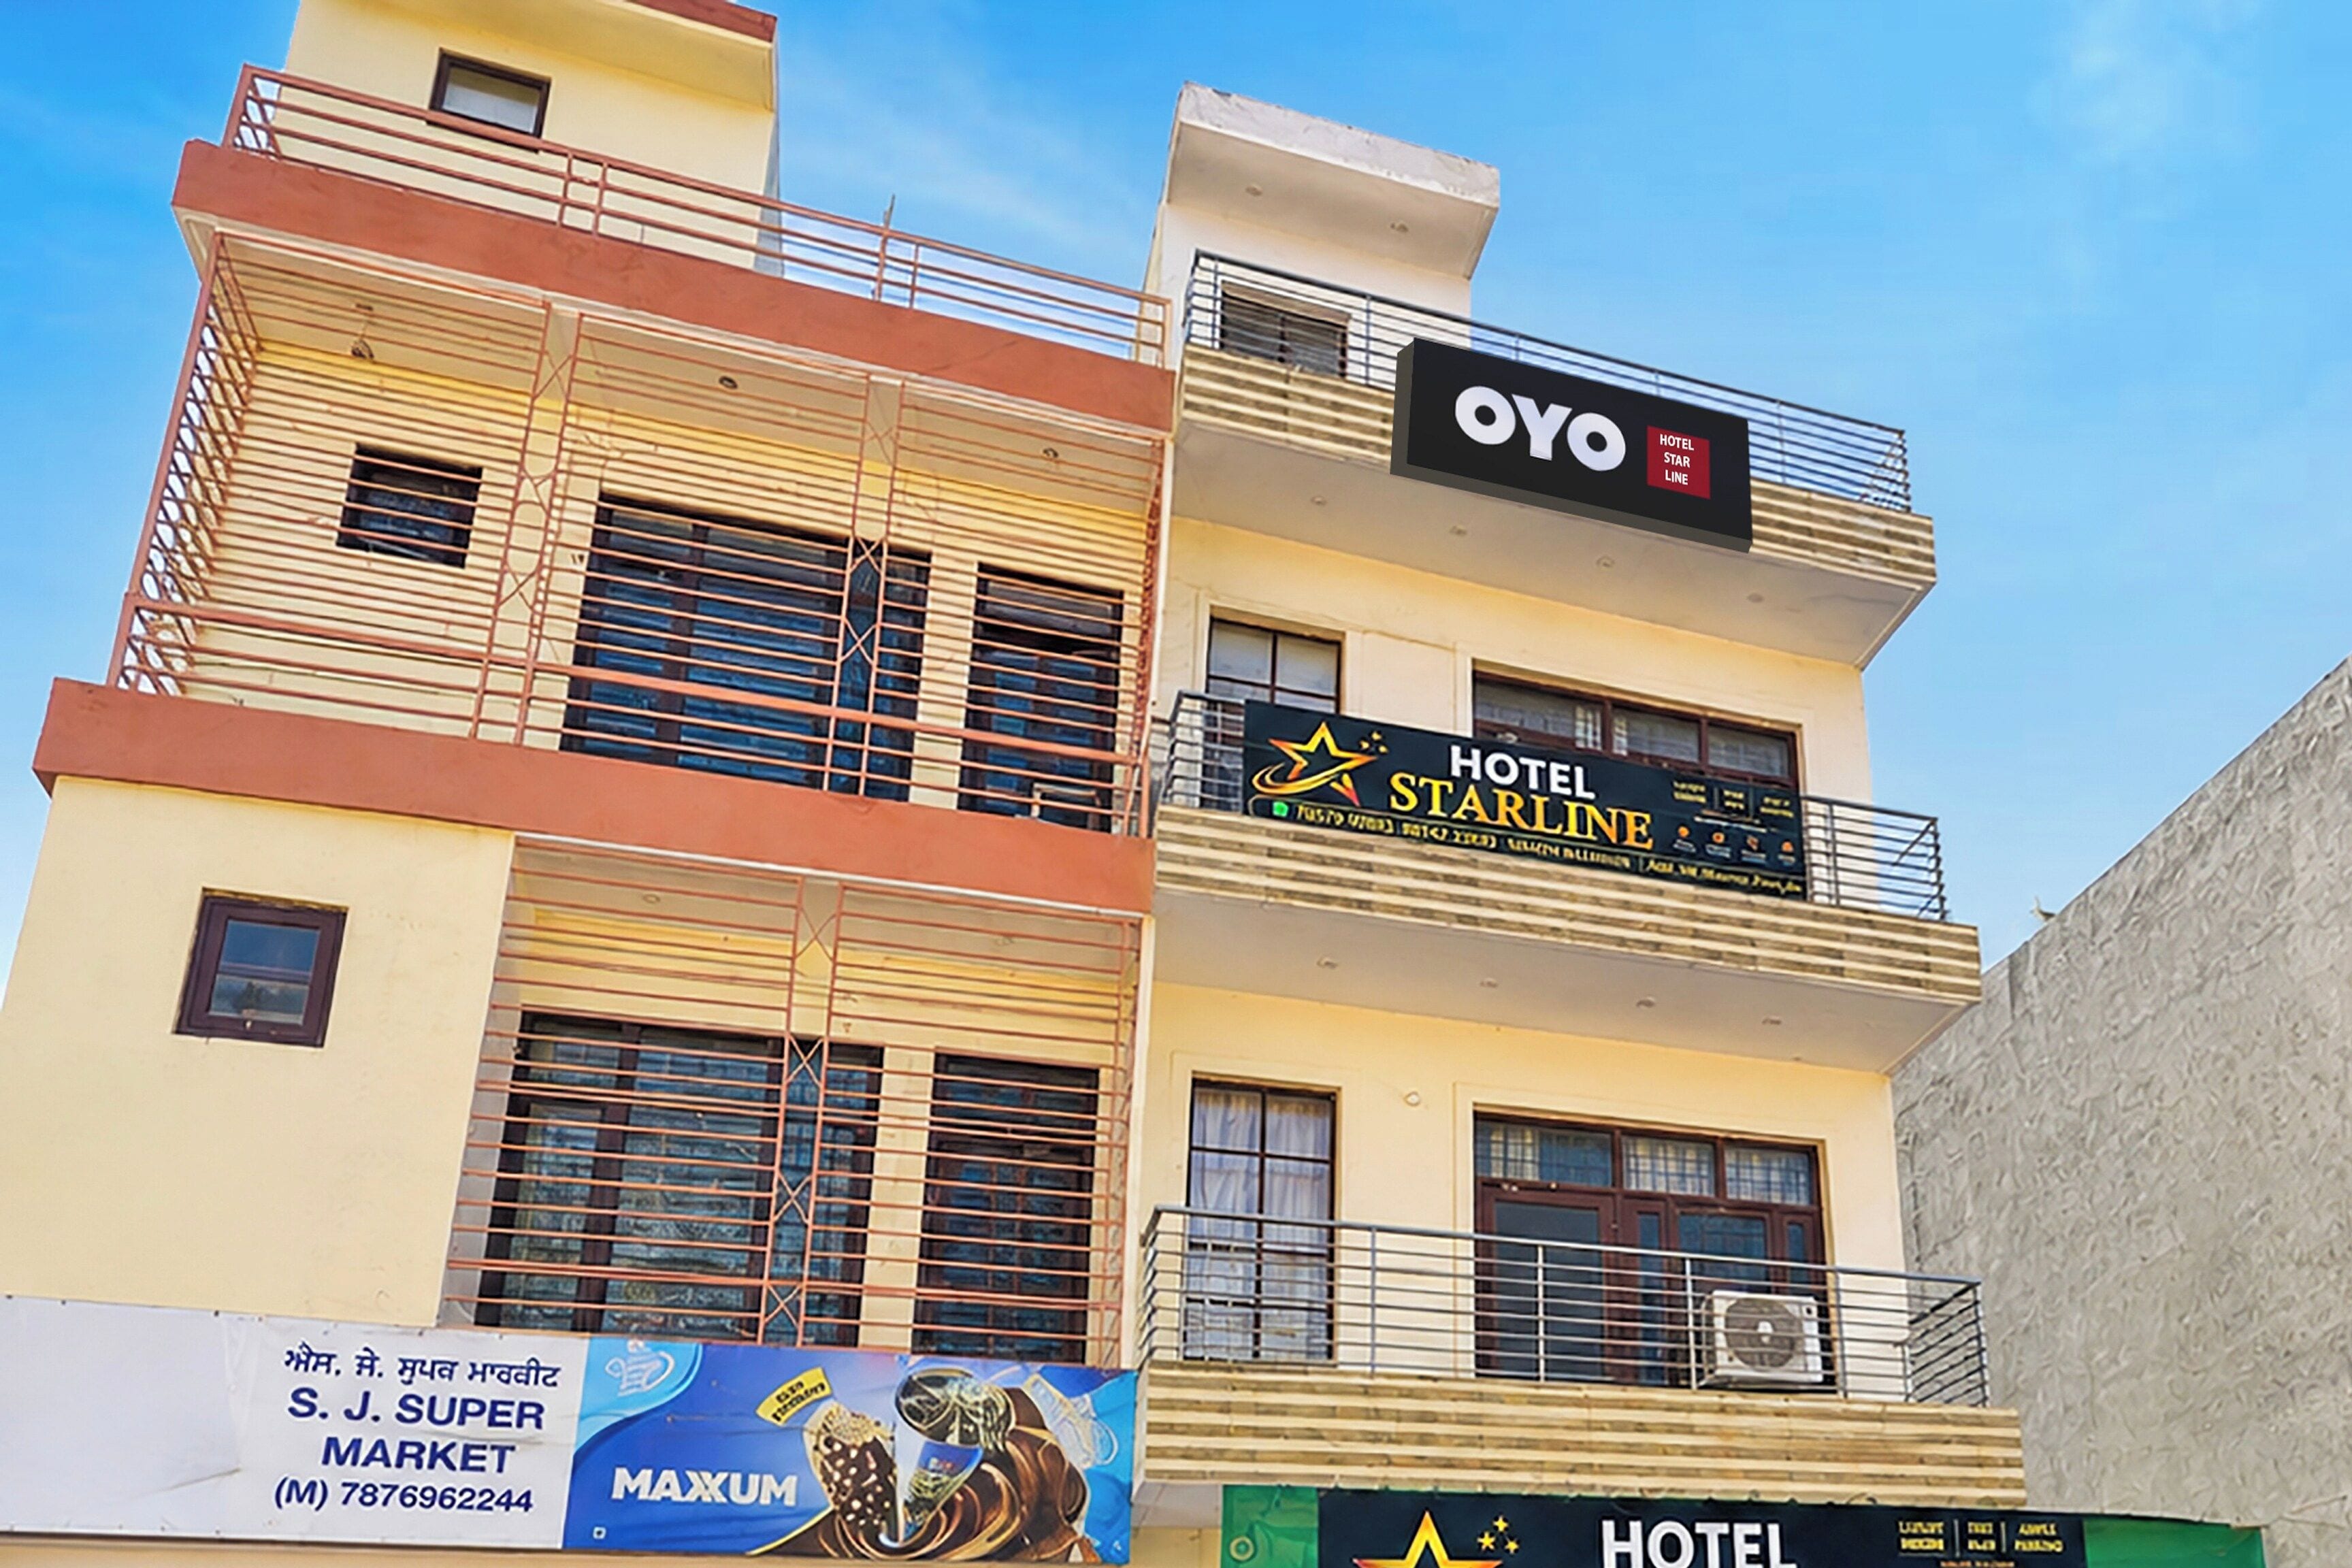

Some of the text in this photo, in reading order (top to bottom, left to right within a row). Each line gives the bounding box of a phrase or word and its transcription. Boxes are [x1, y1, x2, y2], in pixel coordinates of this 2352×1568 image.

[1455, 386, 1626, 471] OYO
[1659, 434, 1695, 451] HOTEL
[1663, 452, 1691, 468] STAR
[1665, 470, 1688, 486] LINE
[1450, 745, 1595, 800] HOTEL
[1388, 771, 1654, 851] STARLINE
[288, 1387, 544, 1430] S. J. SUPER
[322, 1437, 516, 1473] MARKET
[275, 1477, 533, 1512] (M) 7876962244
[612, 1467, 798, 1507] MAXXUM
[1601, 1520, 1798, 1568] HOTEL
